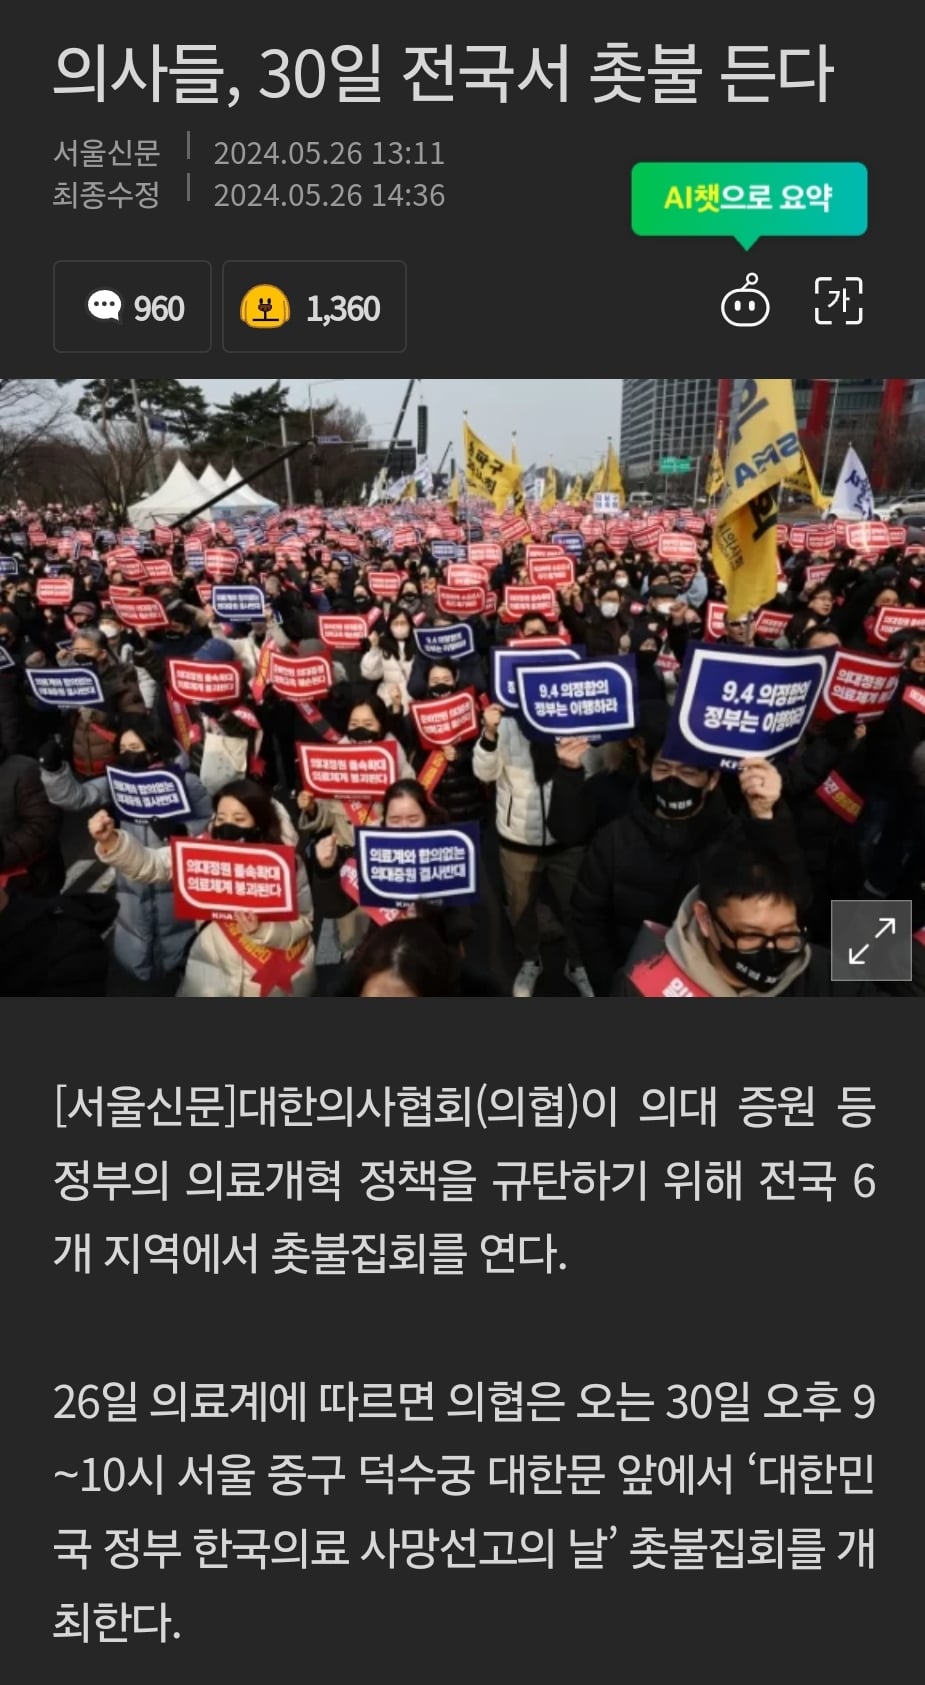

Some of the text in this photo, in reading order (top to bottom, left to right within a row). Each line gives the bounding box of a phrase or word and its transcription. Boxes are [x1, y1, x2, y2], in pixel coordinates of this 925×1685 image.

[539, 683, 559, 698] 9.4
[722, 681, 755, 704] 9.4
[534, 698, 618, 717] 정부는 이행하라
[704, 706, 759, 733] 정부는
[370, 846, 466, 864] 의료계와 합의없는
[186, 859, 231, 877] 의대정원
[371, 866, 416, 882] 의대증원
[420, 863, 466, 882] 결사반대
[187, 878, 233, 895] 의료체계
